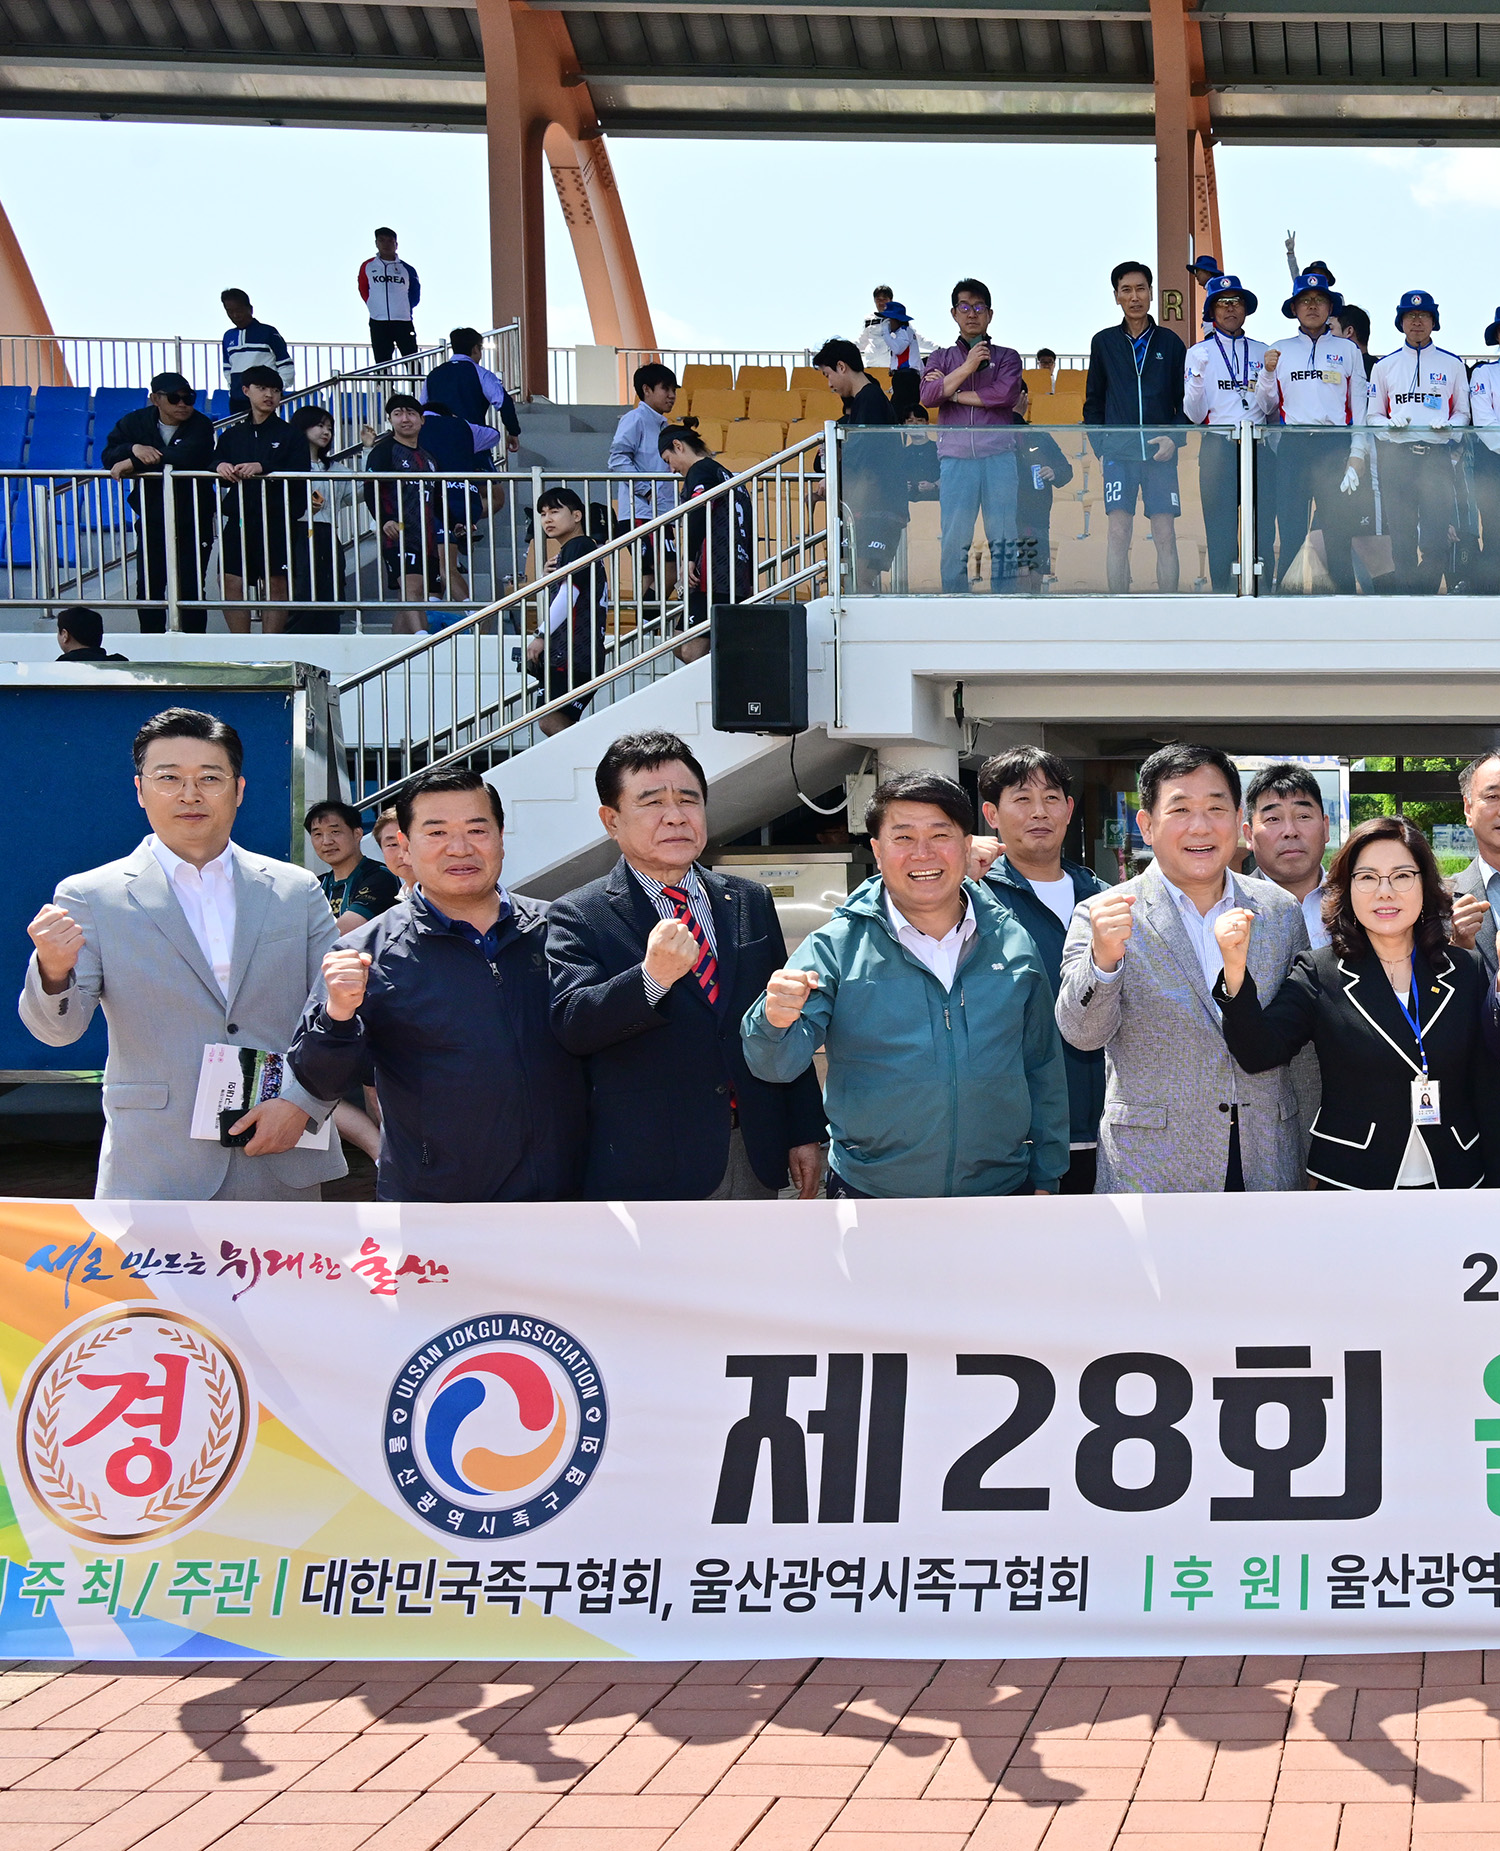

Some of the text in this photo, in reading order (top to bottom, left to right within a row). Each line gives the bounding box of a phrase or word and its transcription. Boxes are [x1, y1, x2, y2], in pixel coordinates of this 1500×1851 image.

[372, 275, 406, 285] KOREA
[1162, 290, 1183, 320] R
[1105, 480, 1122, 502] 22
[25, 1231, 114, 1309] 새로
[217, 1239, 342, 1302] 위대한
[350, 1237, 449, 1296] 울산
[396, 1318, 600, 1400] ULSAN JOKGU ASSOCIATION
[63, 1352, 189, 1498] 경
[711, 1345, 1383, 1524] 제28회
[301, 1557, 673, 1621] 대한민국족구협회,
[689, 1554, 1089, 1614] 울산광역시족구협회
